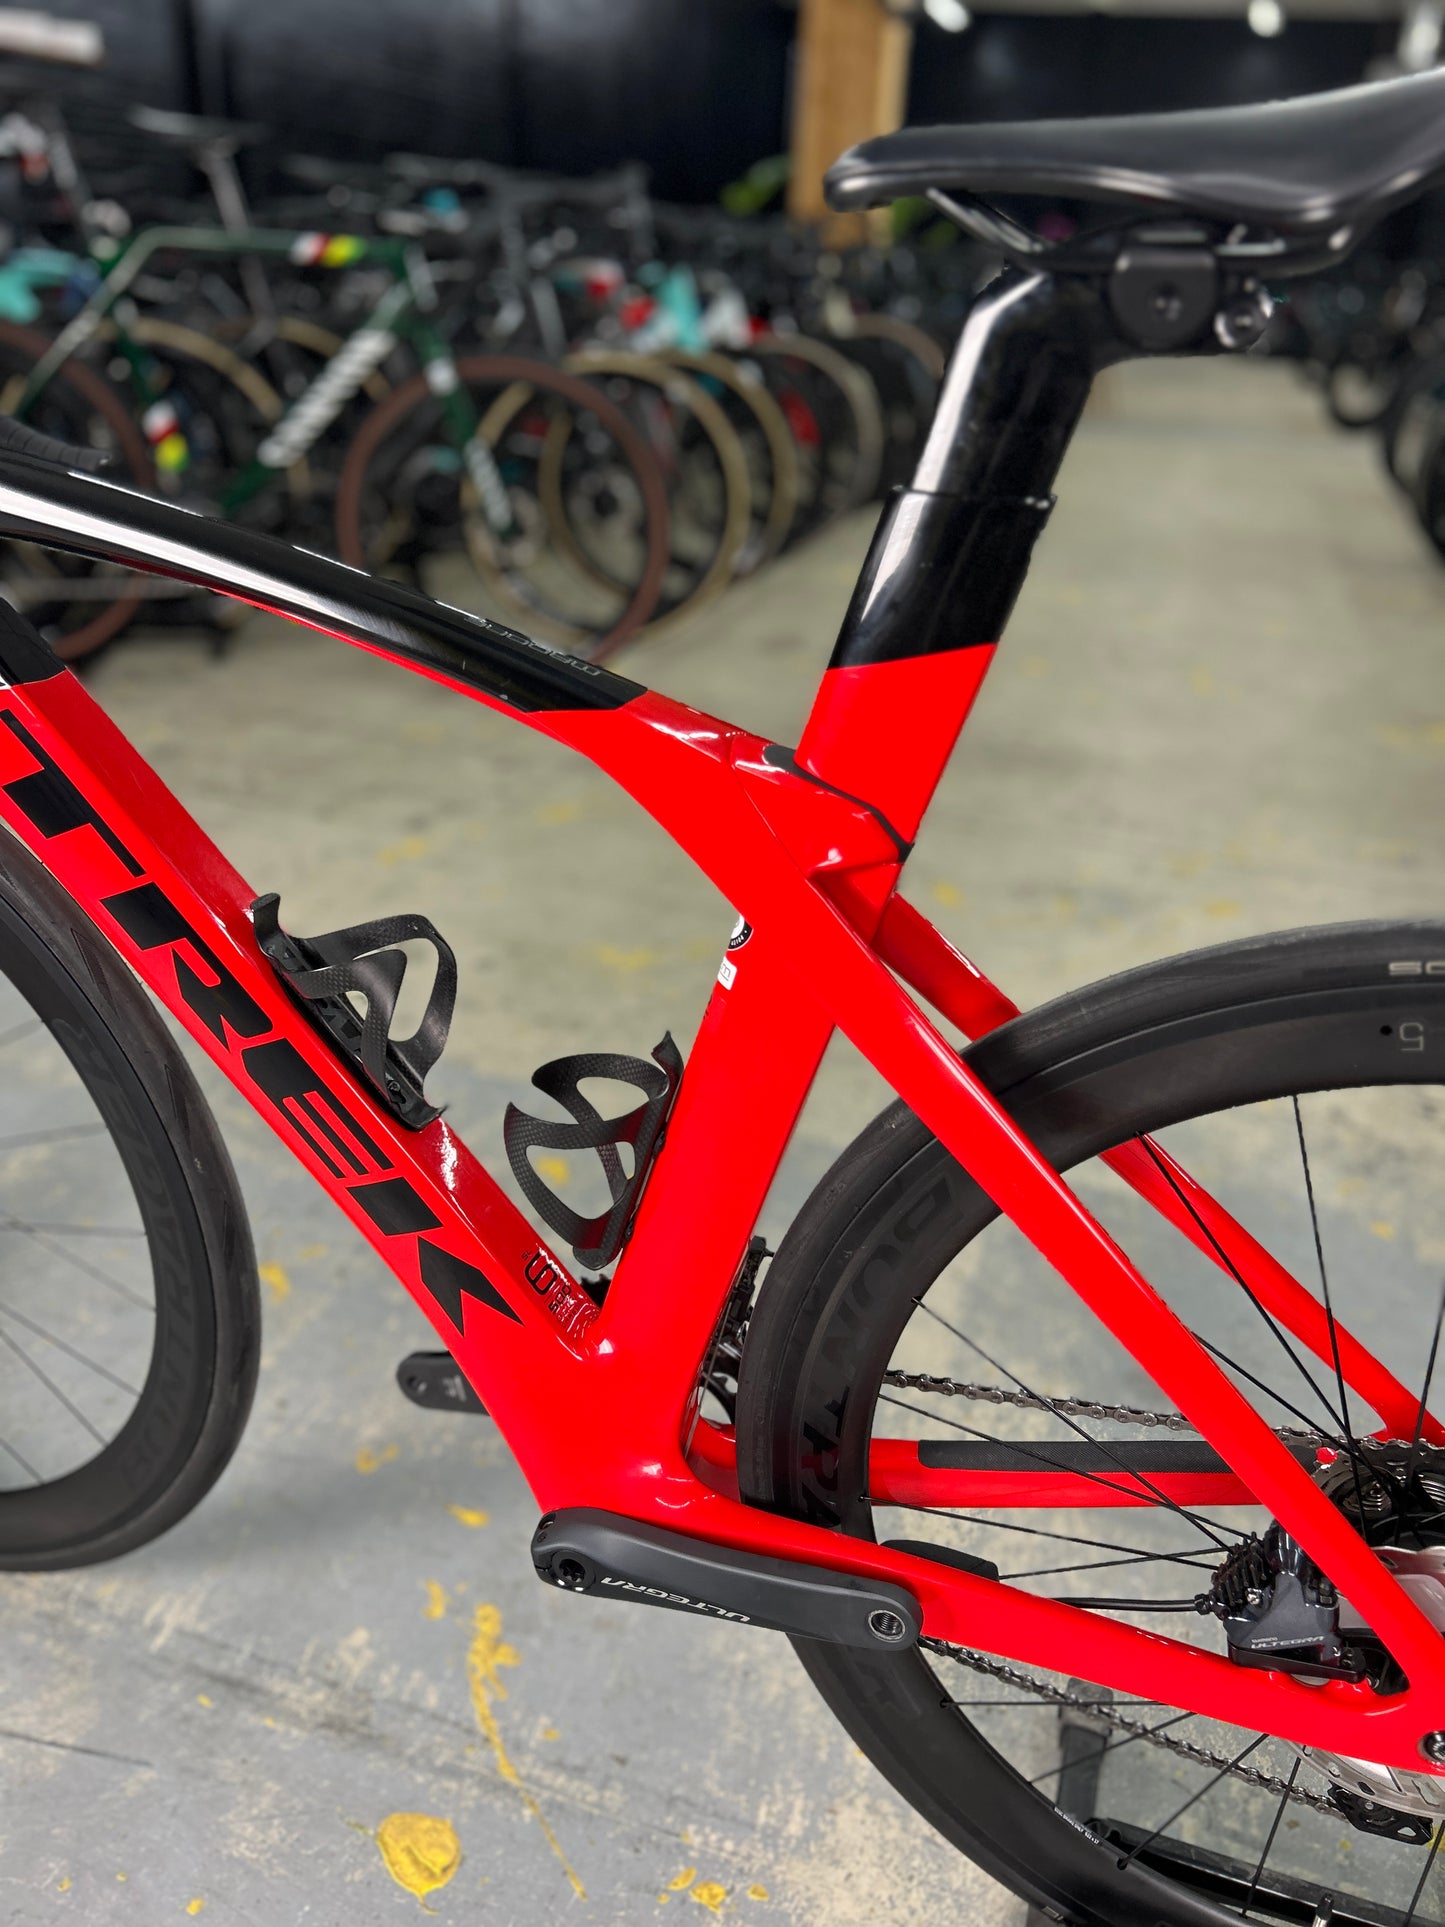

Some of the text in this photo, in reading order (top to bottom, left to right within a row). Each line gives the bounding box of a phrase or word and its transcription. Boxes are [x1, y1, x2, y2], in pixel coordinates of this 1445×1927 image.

[0, 708, 526, 1337] TREK
[1399, 1022, 1424, 1051] 5
[524, 1250, 559, 1296] 6
[548, 1285, 572, 1315] 500
[600, 1577, 751, 1622] ULTEGRA
[1251, 1636, 1324, 1649] ULTEGRA
